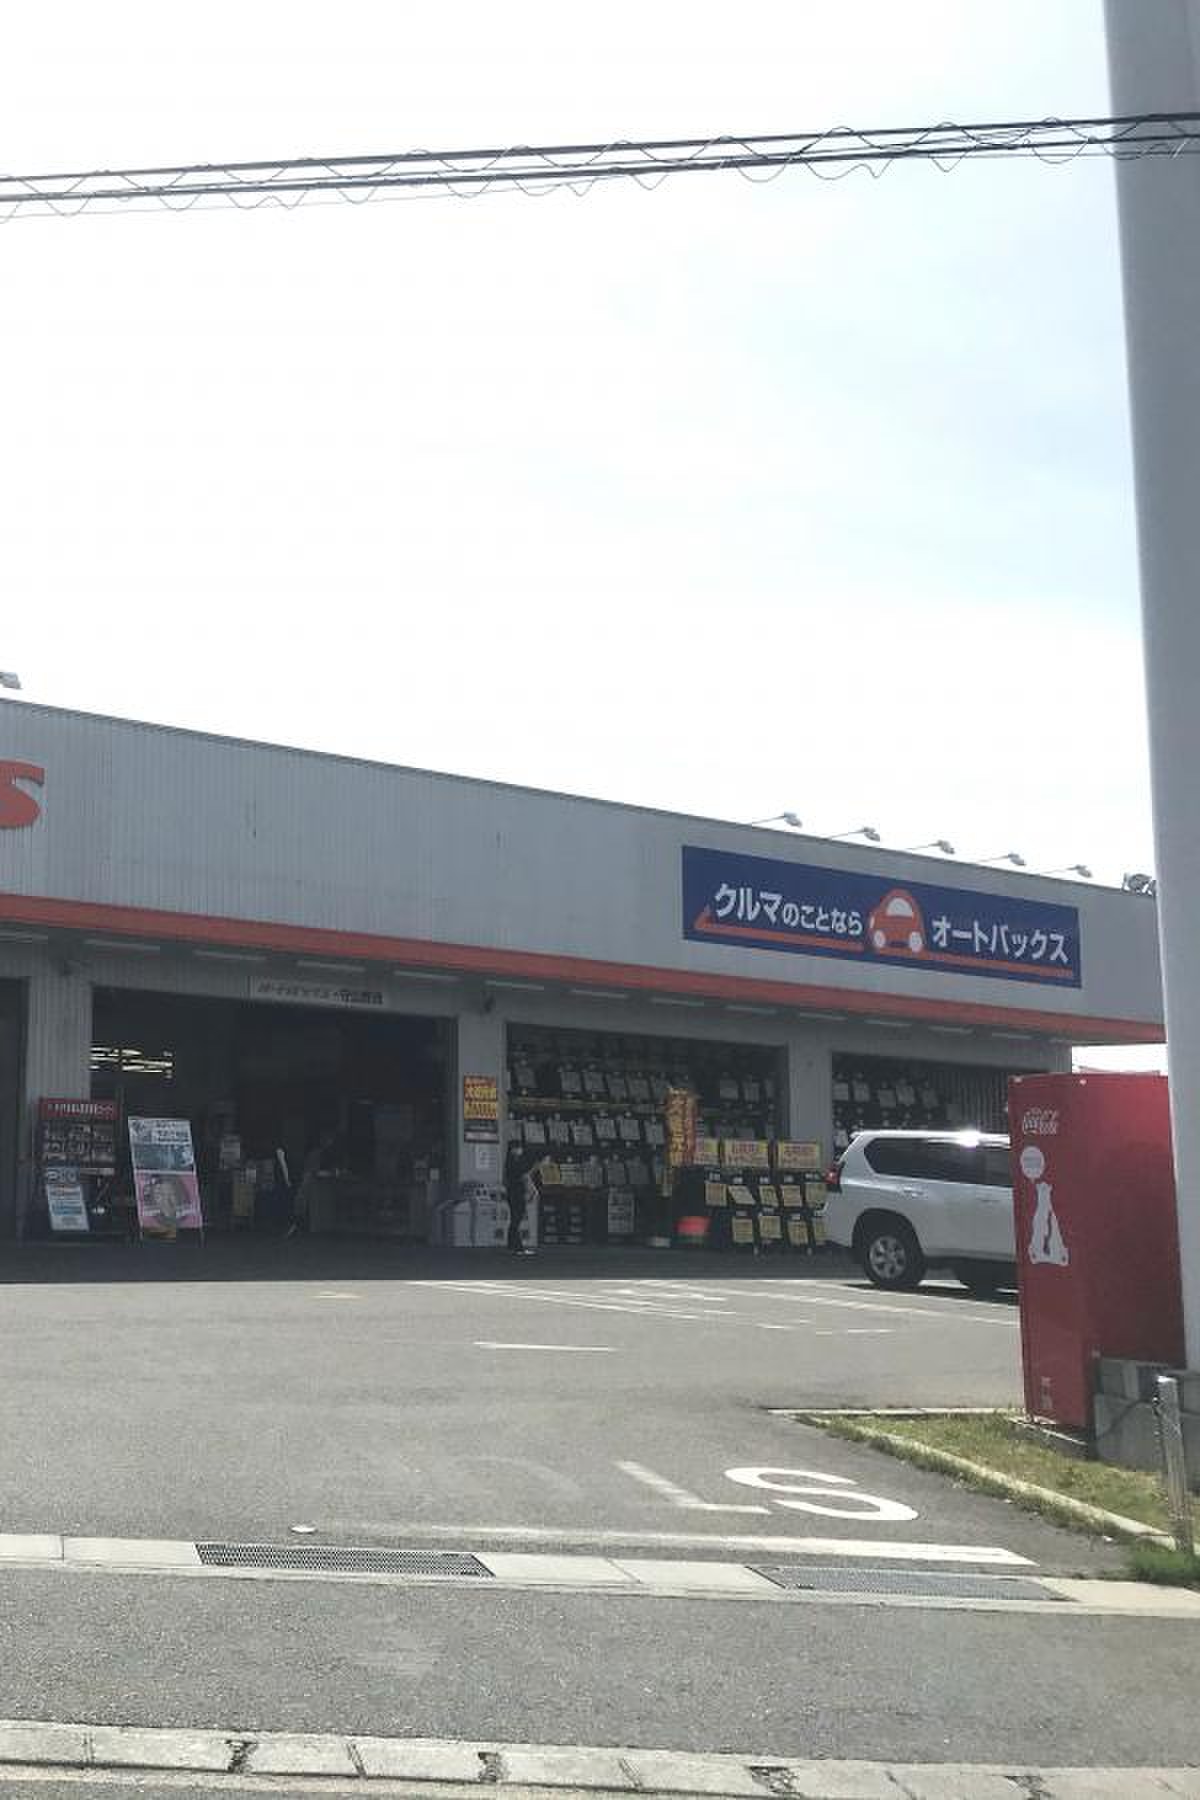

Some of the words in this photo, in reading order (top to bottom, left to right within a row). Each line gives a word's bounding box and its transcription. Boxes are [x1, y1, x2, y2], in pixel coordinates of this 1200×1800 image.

[714, 882, 864, 936] クルマのことなら
[931, 915, 1070, 964] オートバックス
